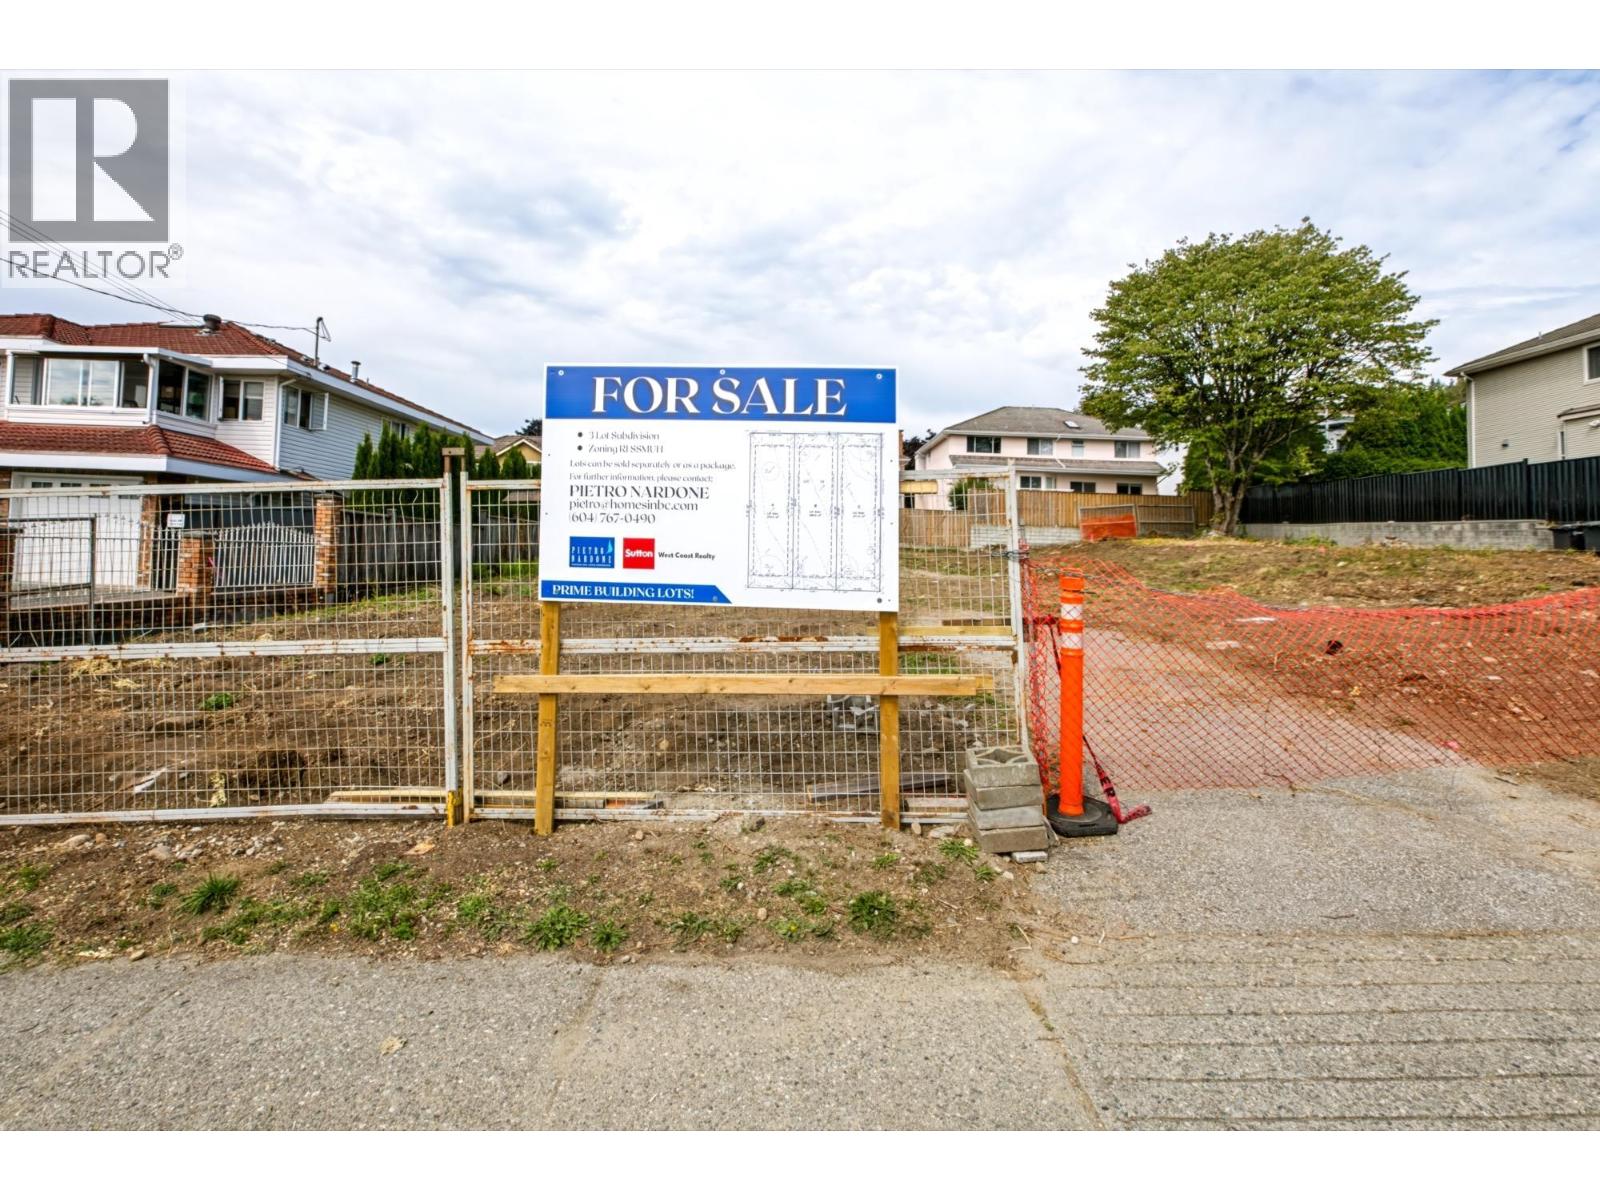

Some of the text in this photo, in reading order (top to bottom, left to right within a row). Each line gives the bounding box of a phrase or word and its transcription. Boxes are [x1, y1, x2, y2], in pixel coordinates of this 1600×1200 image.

[591, 376, 848, 416] FOR SALE
[596, 431, 609, 440] Lot
[610, 431, 660, 440] Subdivision
[588, 444, 618, 455] Zoning
[630, 445, 664, 454] SSMUH
[569, 459, 586, 468] Lots
[603, 459, 613, 468] be
[614, 460, 630, 468] sold
[631, 460, 670, 470] separately
[700, 460, 736, 471] package.
[569, 472, 581, 481] For
[583, 472, 608, 481] further
[610, 473, 656, 482] information,
[656, 474, 682, 483] please
[569, 485, 710, 500] PIETRO NARDONE
[569, 499, 699, 511] pietro@homesinbc.com
[568, 512, 656, 524] (604) 767-0490
[571, 546, 604, 554] PIETRO
[624, 548, 653, 558] Sutton
[571, 554, 612, 563] NARDONE
[658, 551, 716, 561] West Coast Realty
[552, 584, 695, 600] PRIME BUILDING LOTS!
